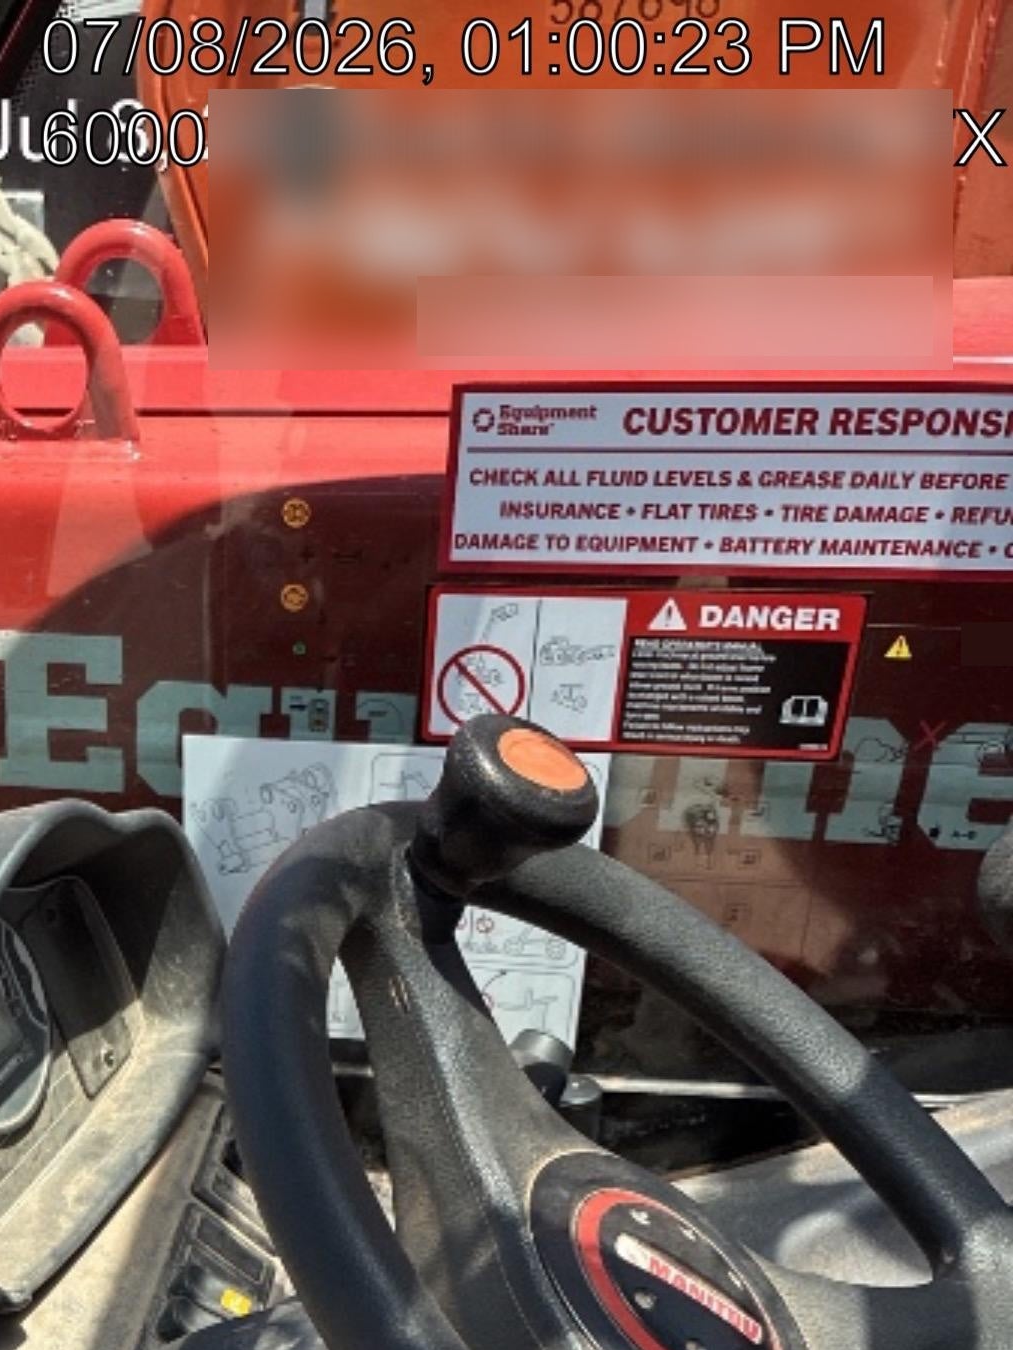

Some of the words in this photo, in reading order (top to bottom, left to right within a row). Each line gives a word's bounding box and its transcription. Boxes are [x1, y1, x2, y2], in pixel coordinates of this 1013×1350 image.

[499, 404, 598, 423] Equipment
[623, 407, 820, 437] CUSTOMER
[469, 468, 539, 487] CHECK
[542, 470, 580, 487] ALL
[586, 470, 649, 487] FLUID
[652, 470, 732, 487] LEVELS
[737, 471, 752, 488] &
[758, 471, 845, 489] GREASE
[849, 471, 915, 489] DAILY
[919, 473, 1009, 490] BEFORE
[500, 501, 621, 520] INSURANCE
[641, 503, 693, 520] FLAT
[697, 503, 758, 521] TIRES
[780, 504, 829, 522] TIRE
[833, 505, 929, 523] DAMAGE
[454, 533, 540, 550] DAMAGE
[545, 534, 571, 551] TO
[575, 536, 699, 553] EQUIPMENT
[719, 536, 815, 555] BATTERY
[818, 539, 982, 558] MAINTENANCE
[698, 605, 841, 631] DANGER
[648, 1256, 761, 1343] MANITOU
